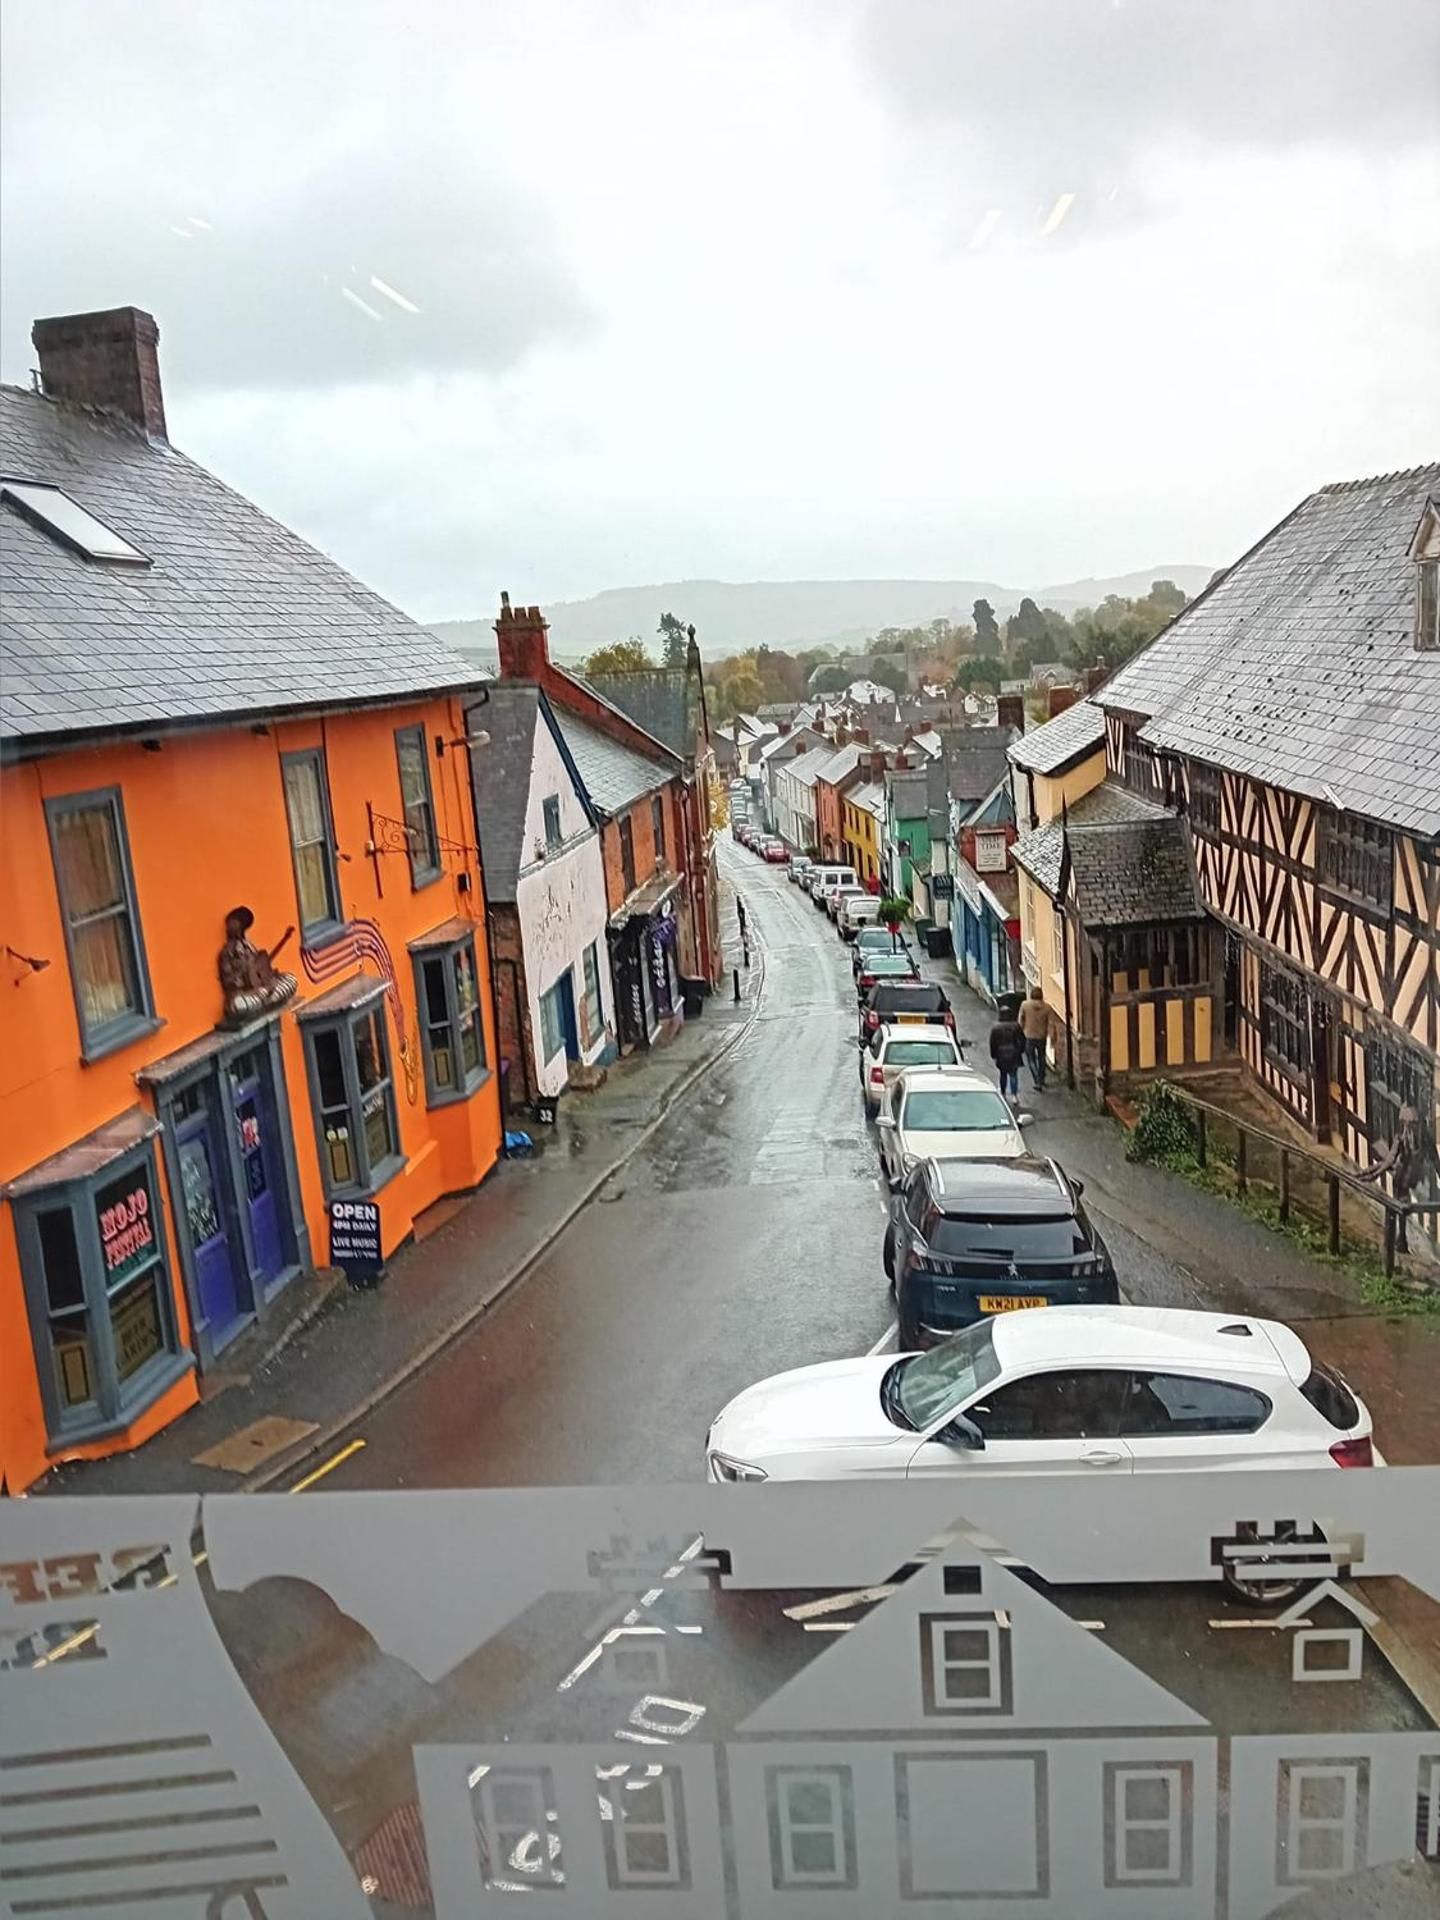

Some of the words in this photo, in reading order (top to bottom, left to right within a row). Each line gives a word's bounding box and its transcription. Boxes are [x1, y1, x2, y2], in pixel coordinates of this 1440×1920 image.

[100, 1188, 147, 1241] MOJO
[332, 1203, 377, 1220] OPEN
[352, 1221, 377, 1231] DAILY
[333, 1236, 350, 1247] LIVE
[351, 1237, 377, 1248] MUSIC
